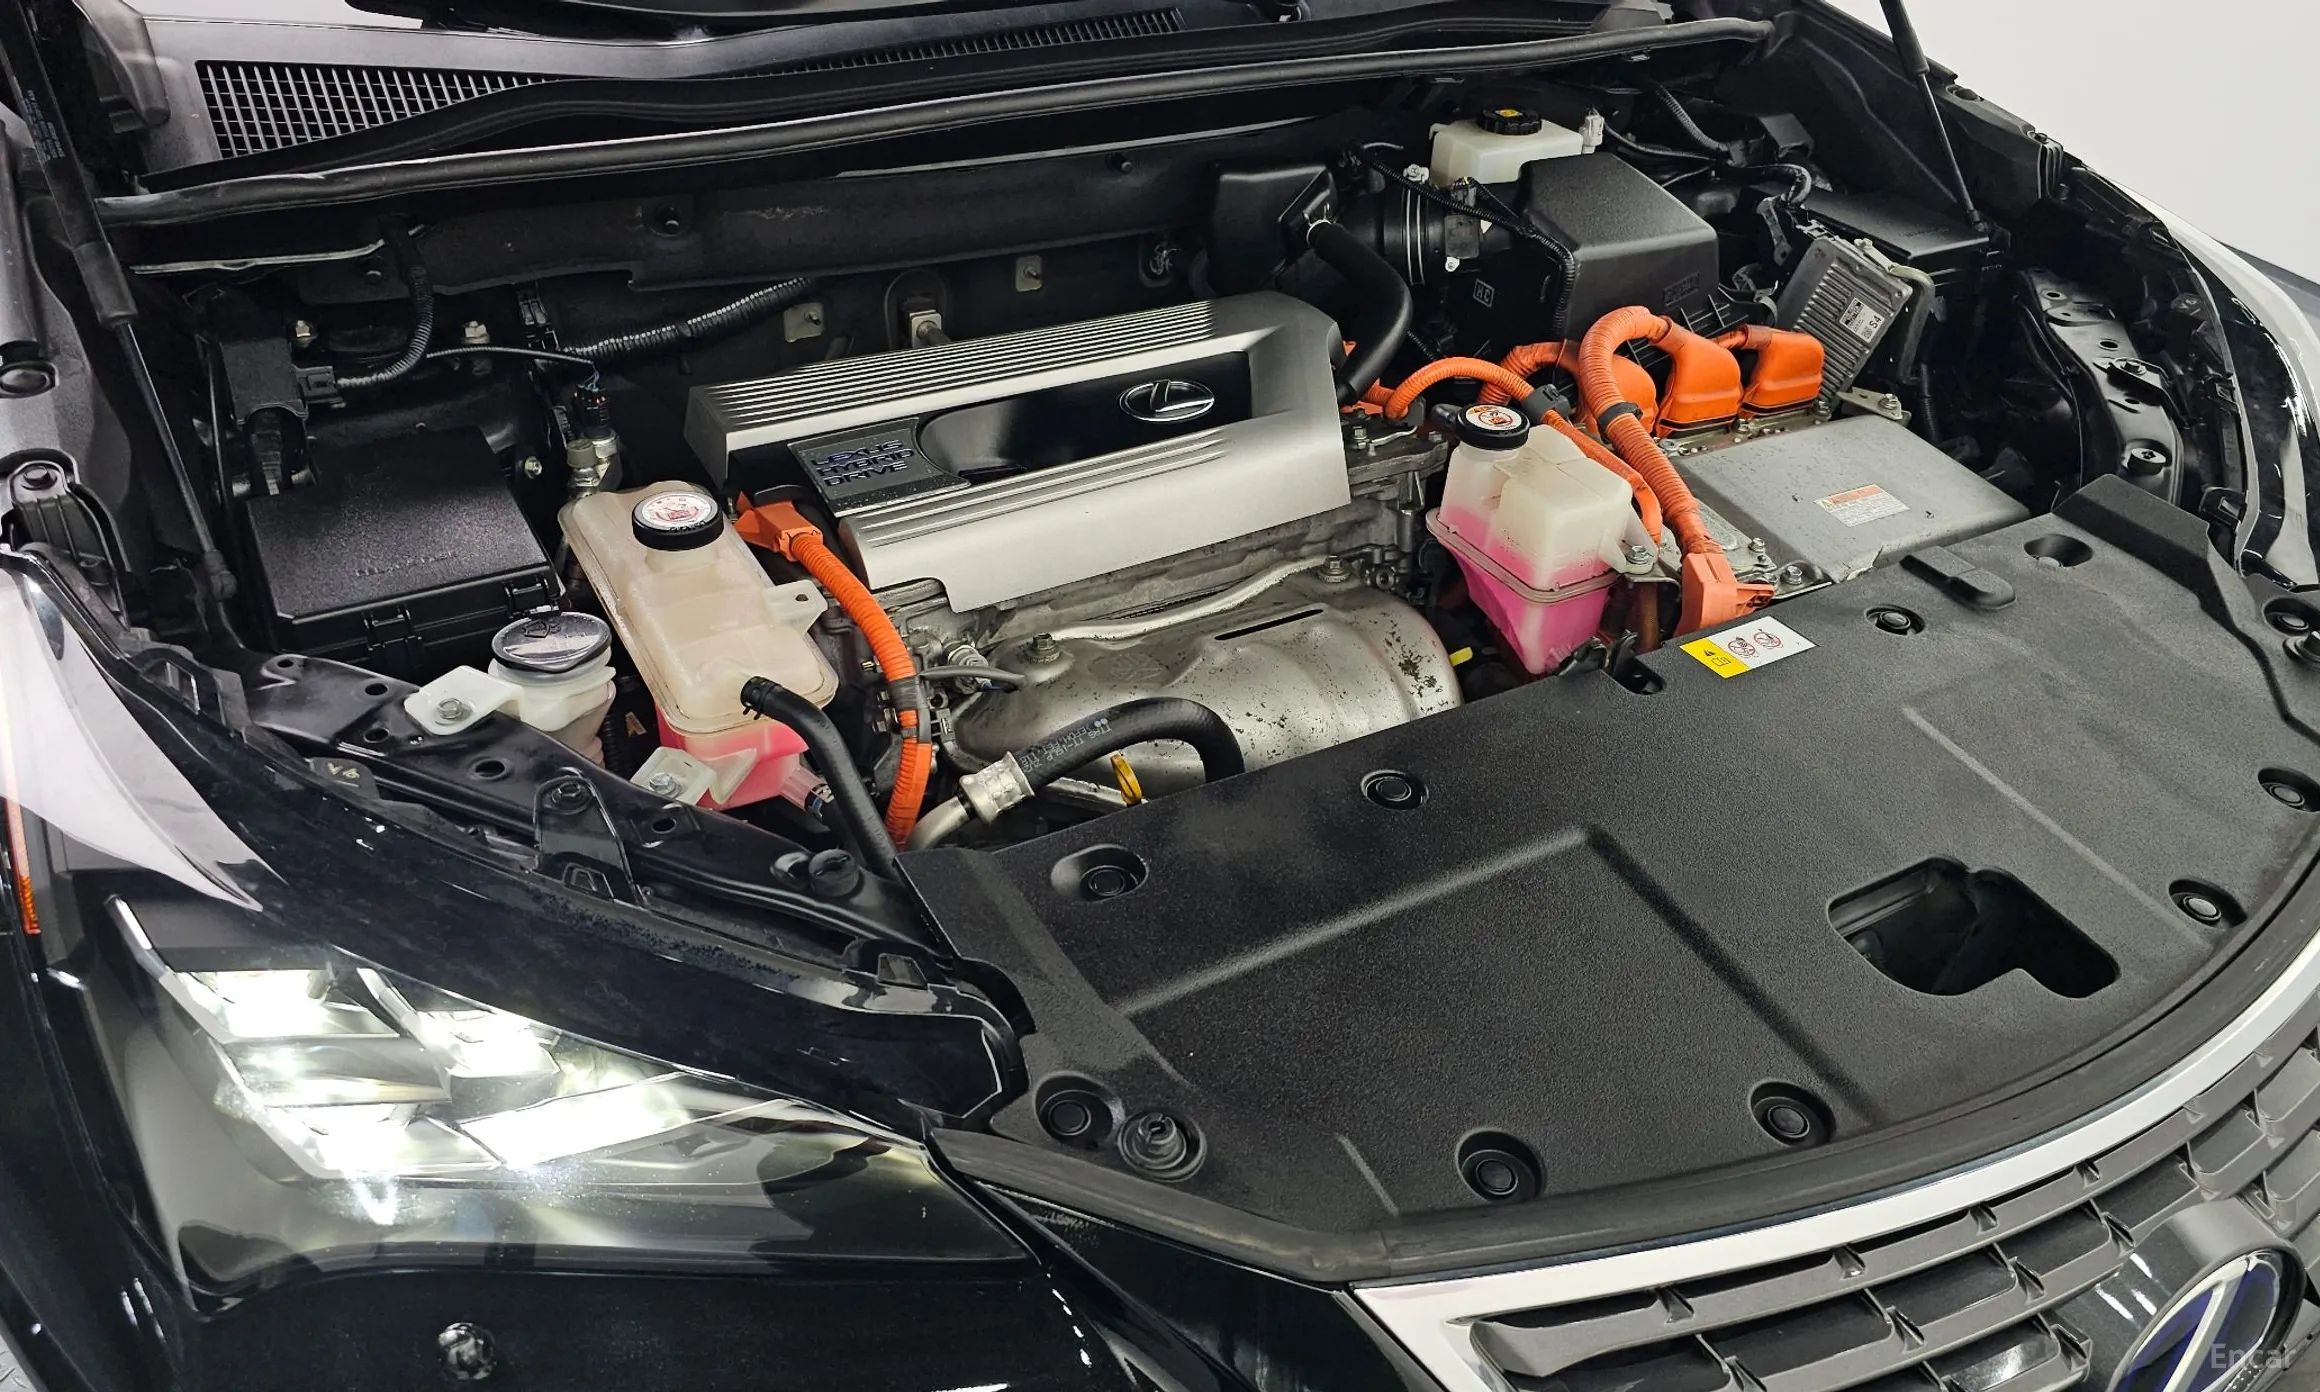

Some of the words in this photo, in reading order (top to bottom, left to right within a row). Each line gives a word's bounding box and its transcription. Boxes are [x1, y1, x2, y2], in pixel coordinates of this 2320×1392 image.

[1869, 315, 1882, 329] S4
[811, 439, 904, 466] LEXUS
[816, 448, 915, 477] HYBRID
[823, 460, 908, 487] DRIVE
